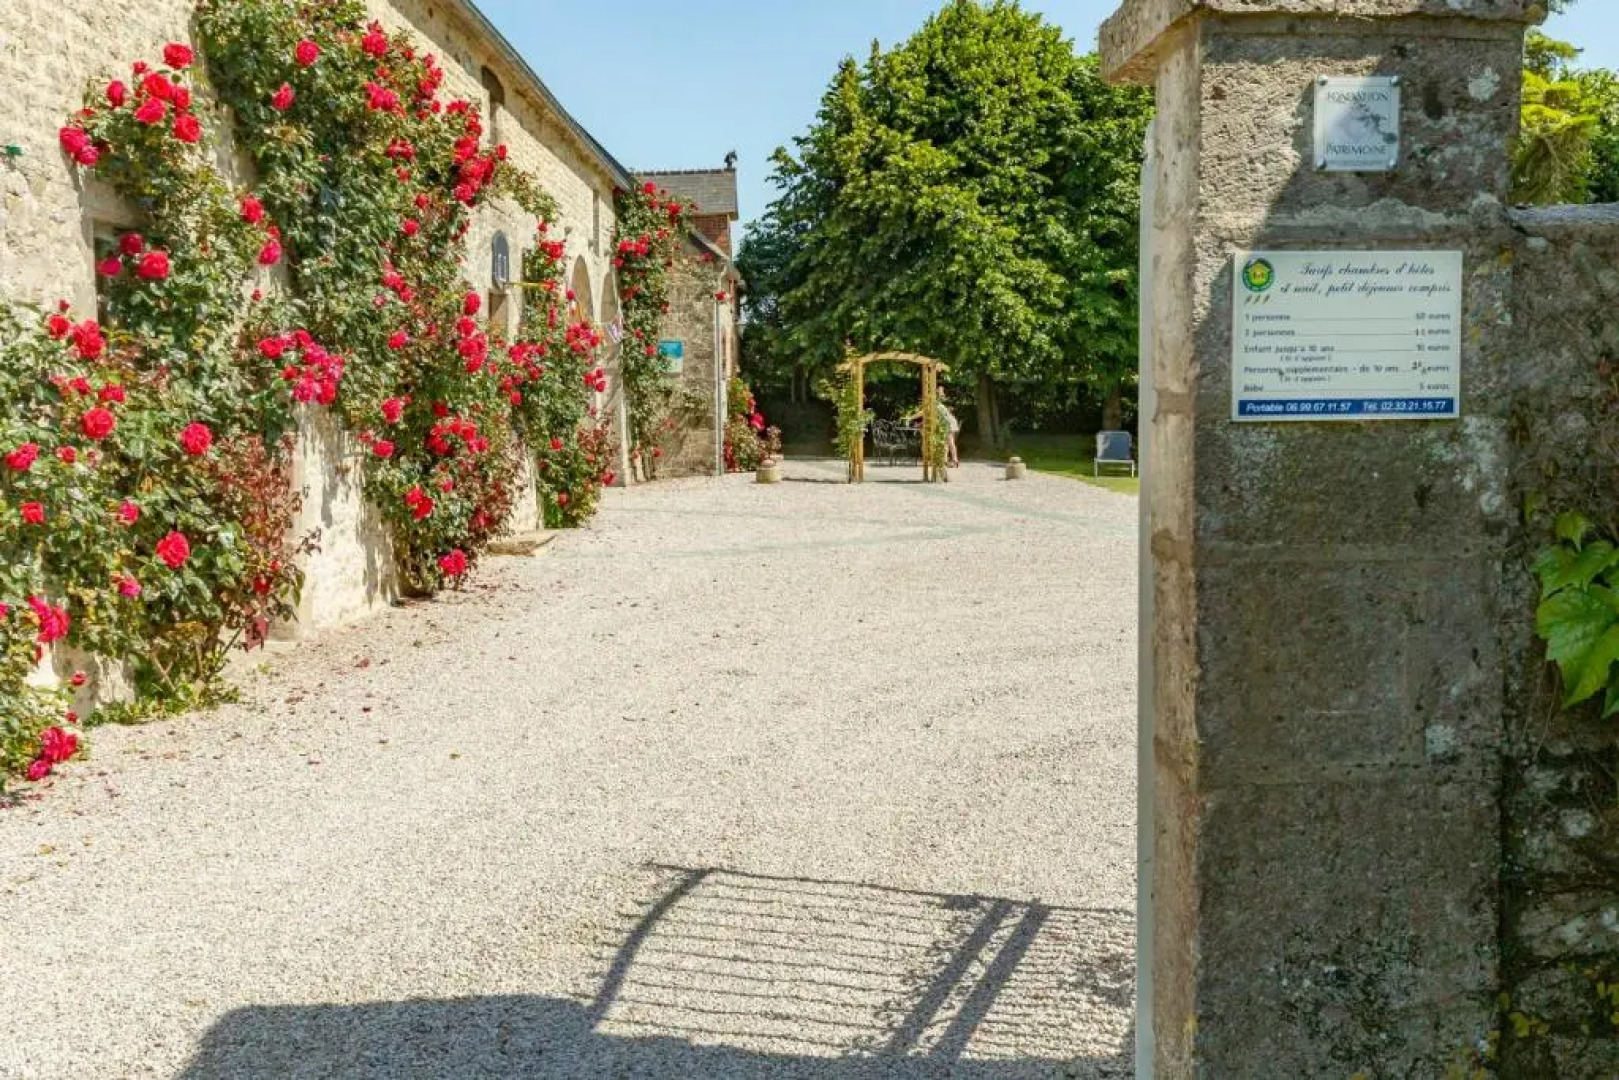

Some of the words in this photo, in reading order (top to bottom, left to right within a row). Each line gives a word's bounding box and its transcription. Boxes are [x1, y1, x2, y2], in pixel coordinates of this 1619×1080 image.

[1338, 261, 1390, 275] chambres
[1408, 281, 1451, 297] compris
[1251, 314, 1291, 323] personne
[1252, 329, 1296, 338] personnes
[1243, 345, 1272, 354] Enfant
[1245, 402, 1284, 413] Portable
